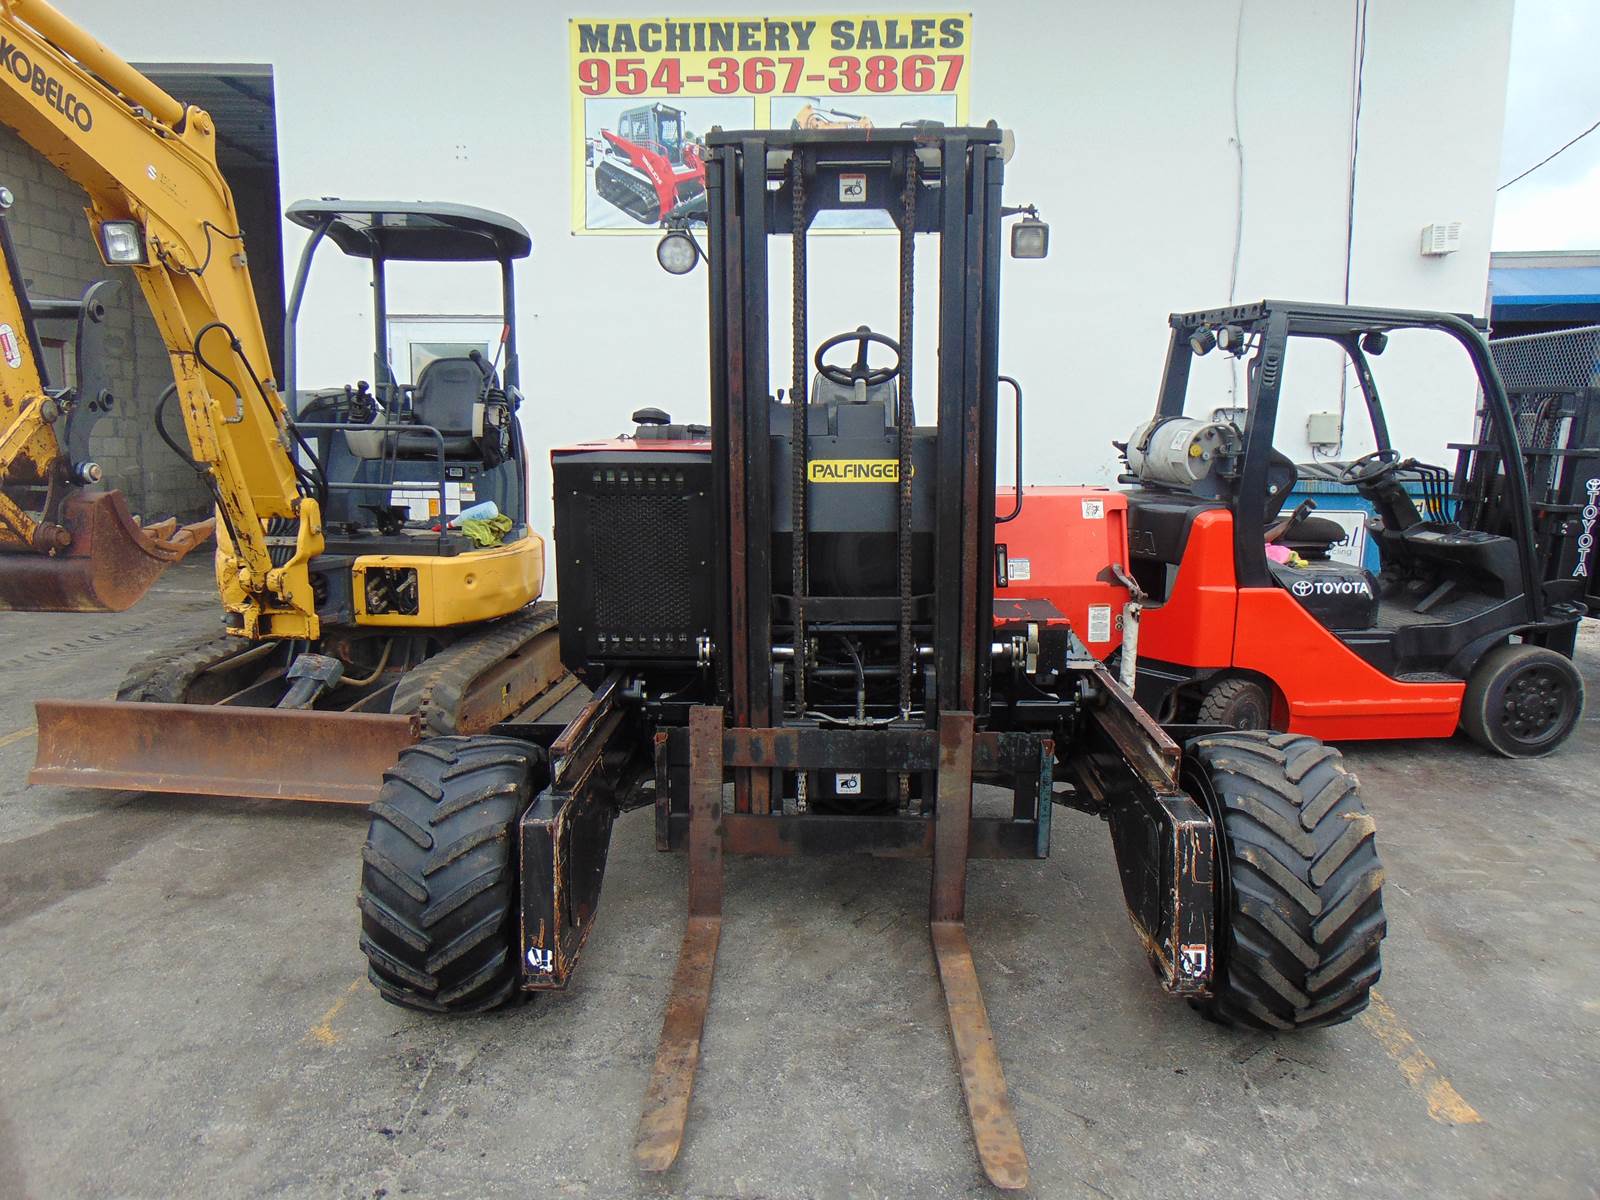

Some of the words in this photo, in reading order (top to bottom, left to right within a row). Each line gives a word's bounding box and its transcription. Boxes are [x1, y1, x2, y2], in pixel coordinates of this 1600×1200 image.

[578, 21, 816, 53] MACHINERY
[831, 18, 964, 50] SALES
[0, 35, 92, 132] KOBELCO
[578, 55, 964, 95] 954-367-3867
[1572, 490, 1600, 576] TOYOTA
[1314, 582, 1370, 595] TOYOTA
